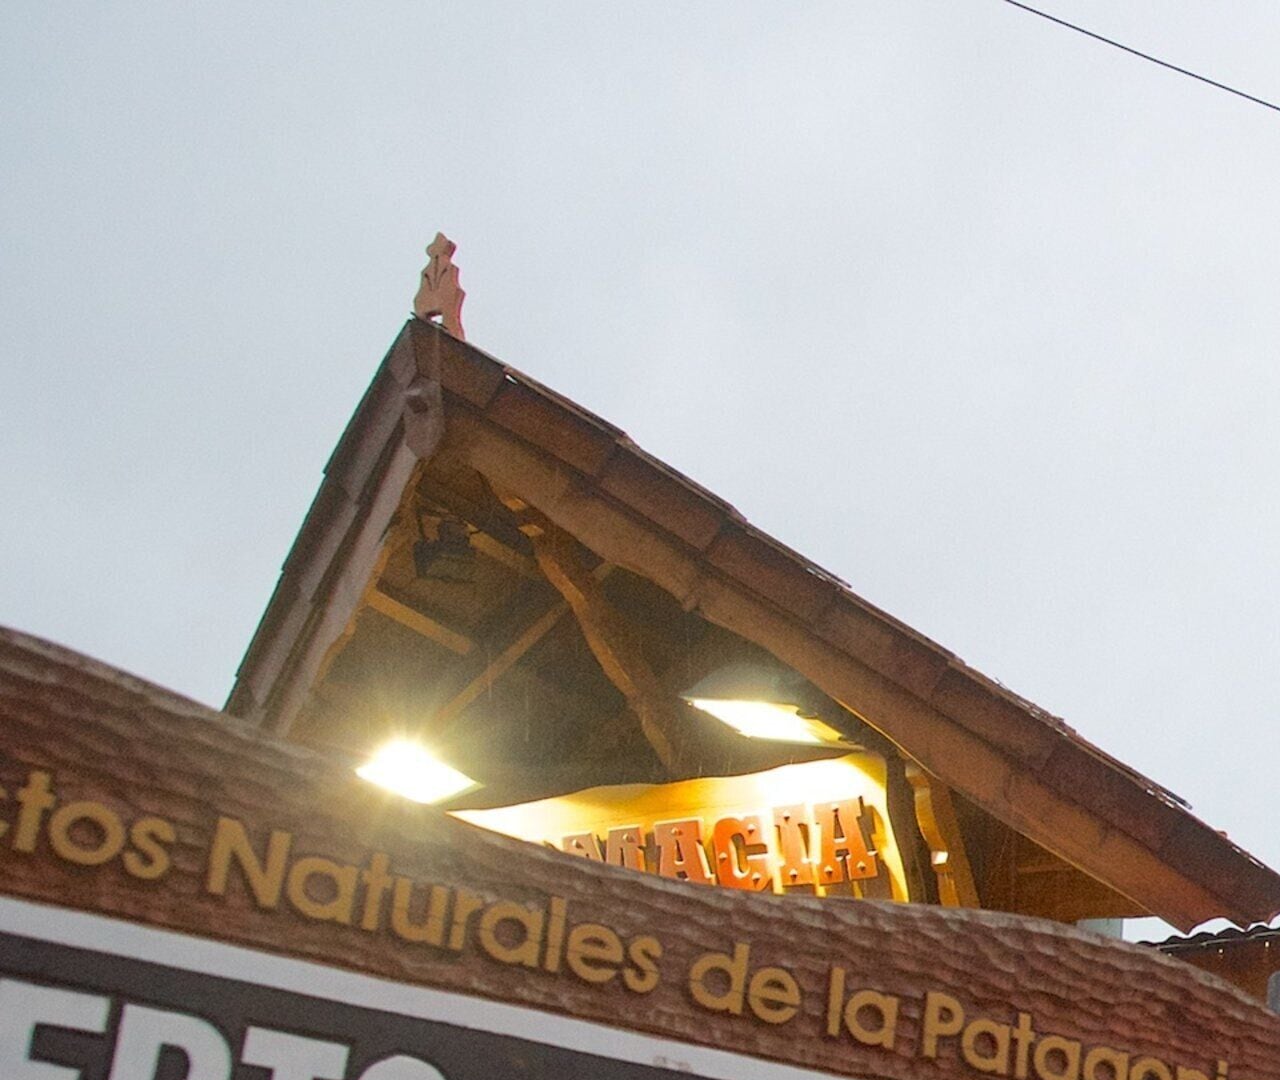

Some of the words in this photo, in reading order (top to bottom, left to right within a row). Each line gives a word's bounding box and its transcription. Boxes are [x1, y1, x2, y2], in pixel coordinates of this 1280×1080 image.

[0, 770, 177, 880] tos
[207, 815, 664, 994] Naturales
[690, 943, 799, 1024] de
[828, 967, 900, 1050] la
